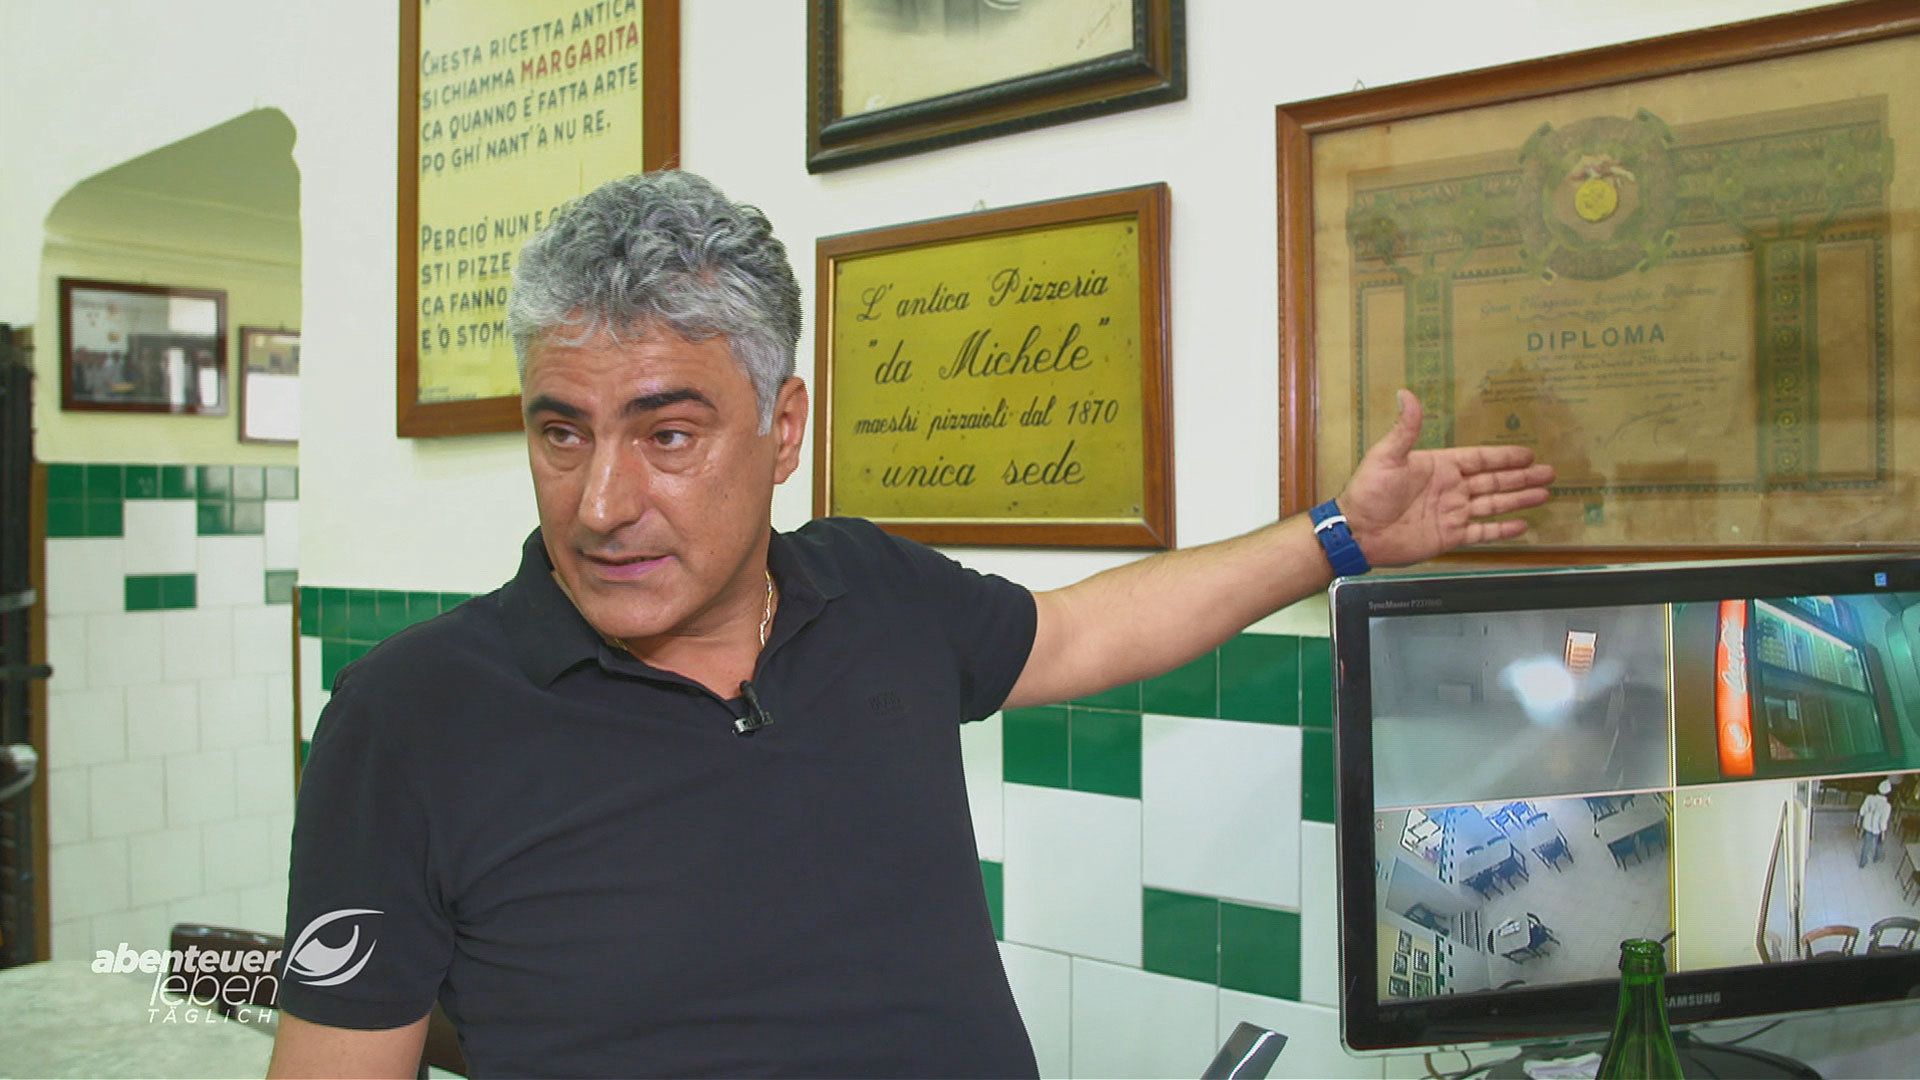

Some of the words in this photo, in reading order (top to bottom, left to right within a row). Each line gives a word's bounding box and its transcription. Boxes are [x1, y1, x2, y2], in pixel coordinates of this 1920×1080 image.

[422, 45, 482, 77] CHESTA
[489, 18, 565, 58] RICETTA
[571, 0, 637, 35] ANTICA
[421, 88, 439, 110] SI
[441, 68, 516, 105] CHIAMMA
[520, 20, 639, 83] MARGARITA
[421, 120, 444, 143] CA
[449, 101, 517, 141] QUANNO
[537, 80, 588, 113] FATTA
[593, 62, 639, 95] ARTE
[421, 152, 446, 174] PO
[553, 119, 577, 145] NU
[582, 109, 612, 136] RE.
[494, 214, 530, 239] NUN
[421, 262, 451, 286] STI
[457, 252, 512, 280] PIZZE
[988, 266, 1109, 308] Pizzeria
[421, 296, 444, 317] CA
[450, 287, 507, 313] FANNO
[421, 329, 432, 350] E
[1527, 323, 1665, 353] DIPLOMA
[853, 404, 921, 437] maestri
[927, 397, 1008, 440] pizzaioli
[1020, 394, 1056, 427] dal
[1067, 398, 1120, 426] 1870
[881, 453, 976, 490] unica
[1002, 439, 1086, 487] sede
